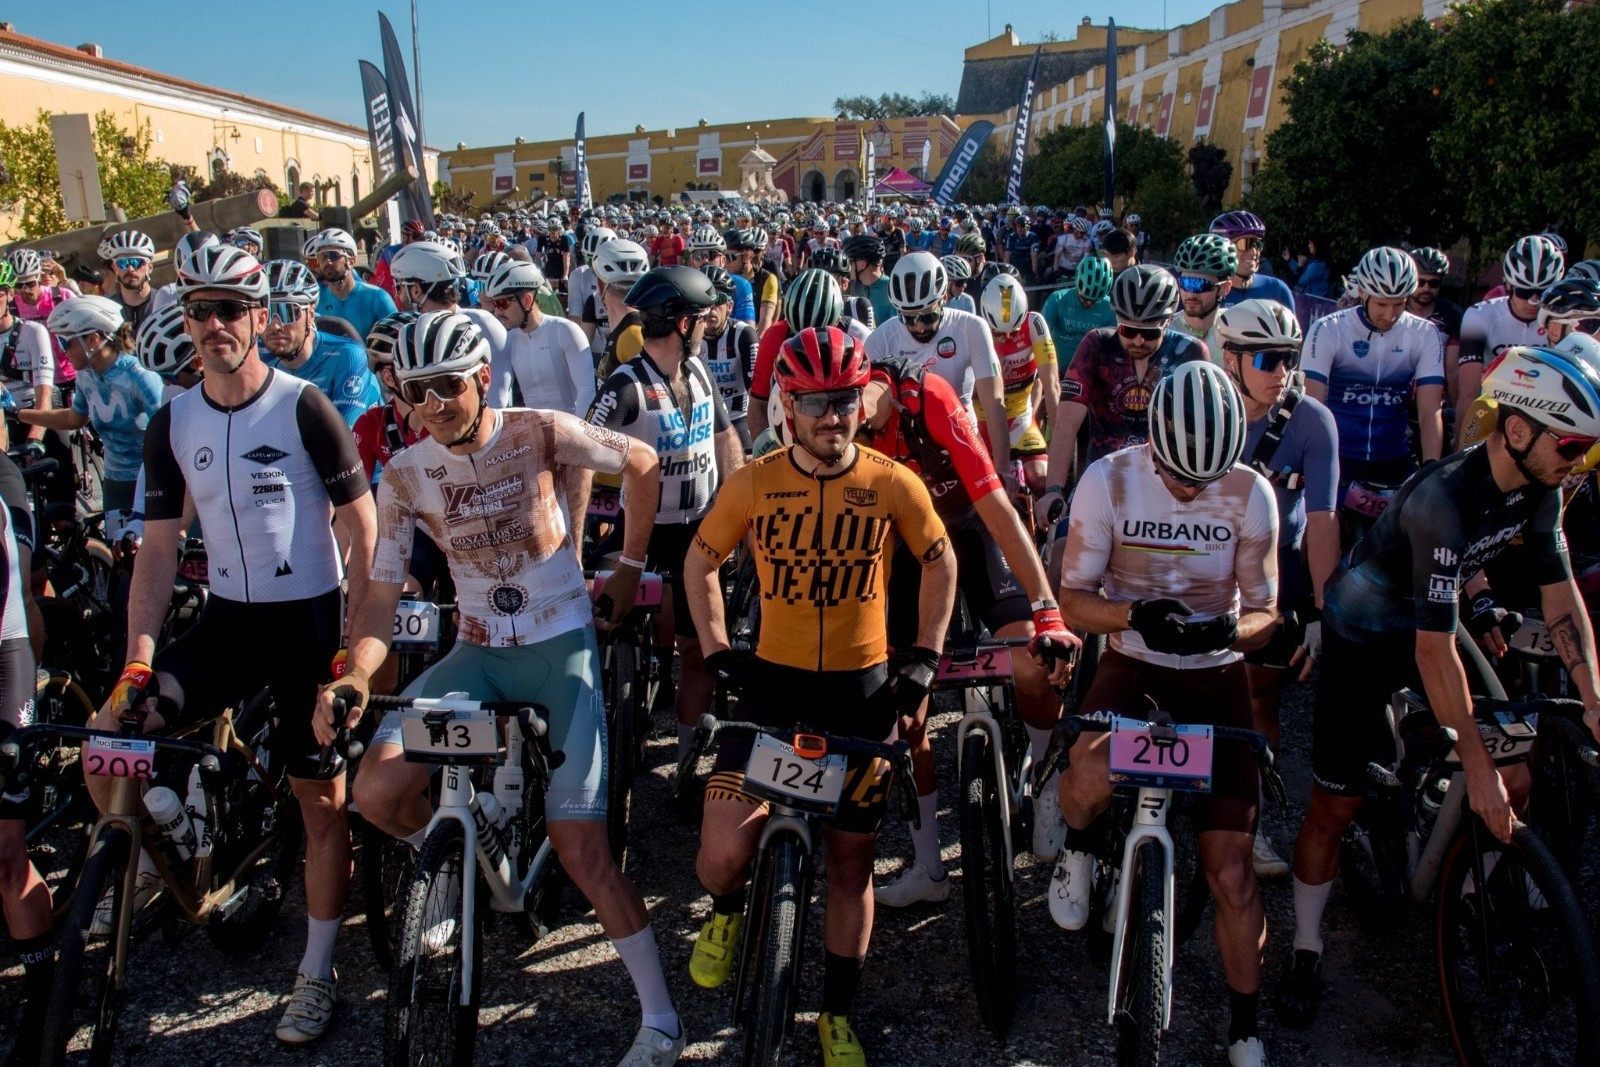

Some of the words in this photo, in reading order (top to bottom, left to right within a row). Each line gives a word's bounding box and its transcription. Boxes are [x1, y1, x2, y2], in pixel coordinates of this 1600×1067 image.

[1492, 389, 1571, 413] SPECIALIZED
[251, 470, 285, 480] VESKIN
[252, 483, 284, 495] 226ERS
[764, 490, 811, 500] TREK
[844, 488, 877, 500] YELLOW
[1122, 520, 1232, 542] URBANO
[1205, 543, 1228, 551] BIKE
[1132, 735, 1190, 767] 210
[88, 754, 153, 778] 208
[770, 757, 824, 794] 124
